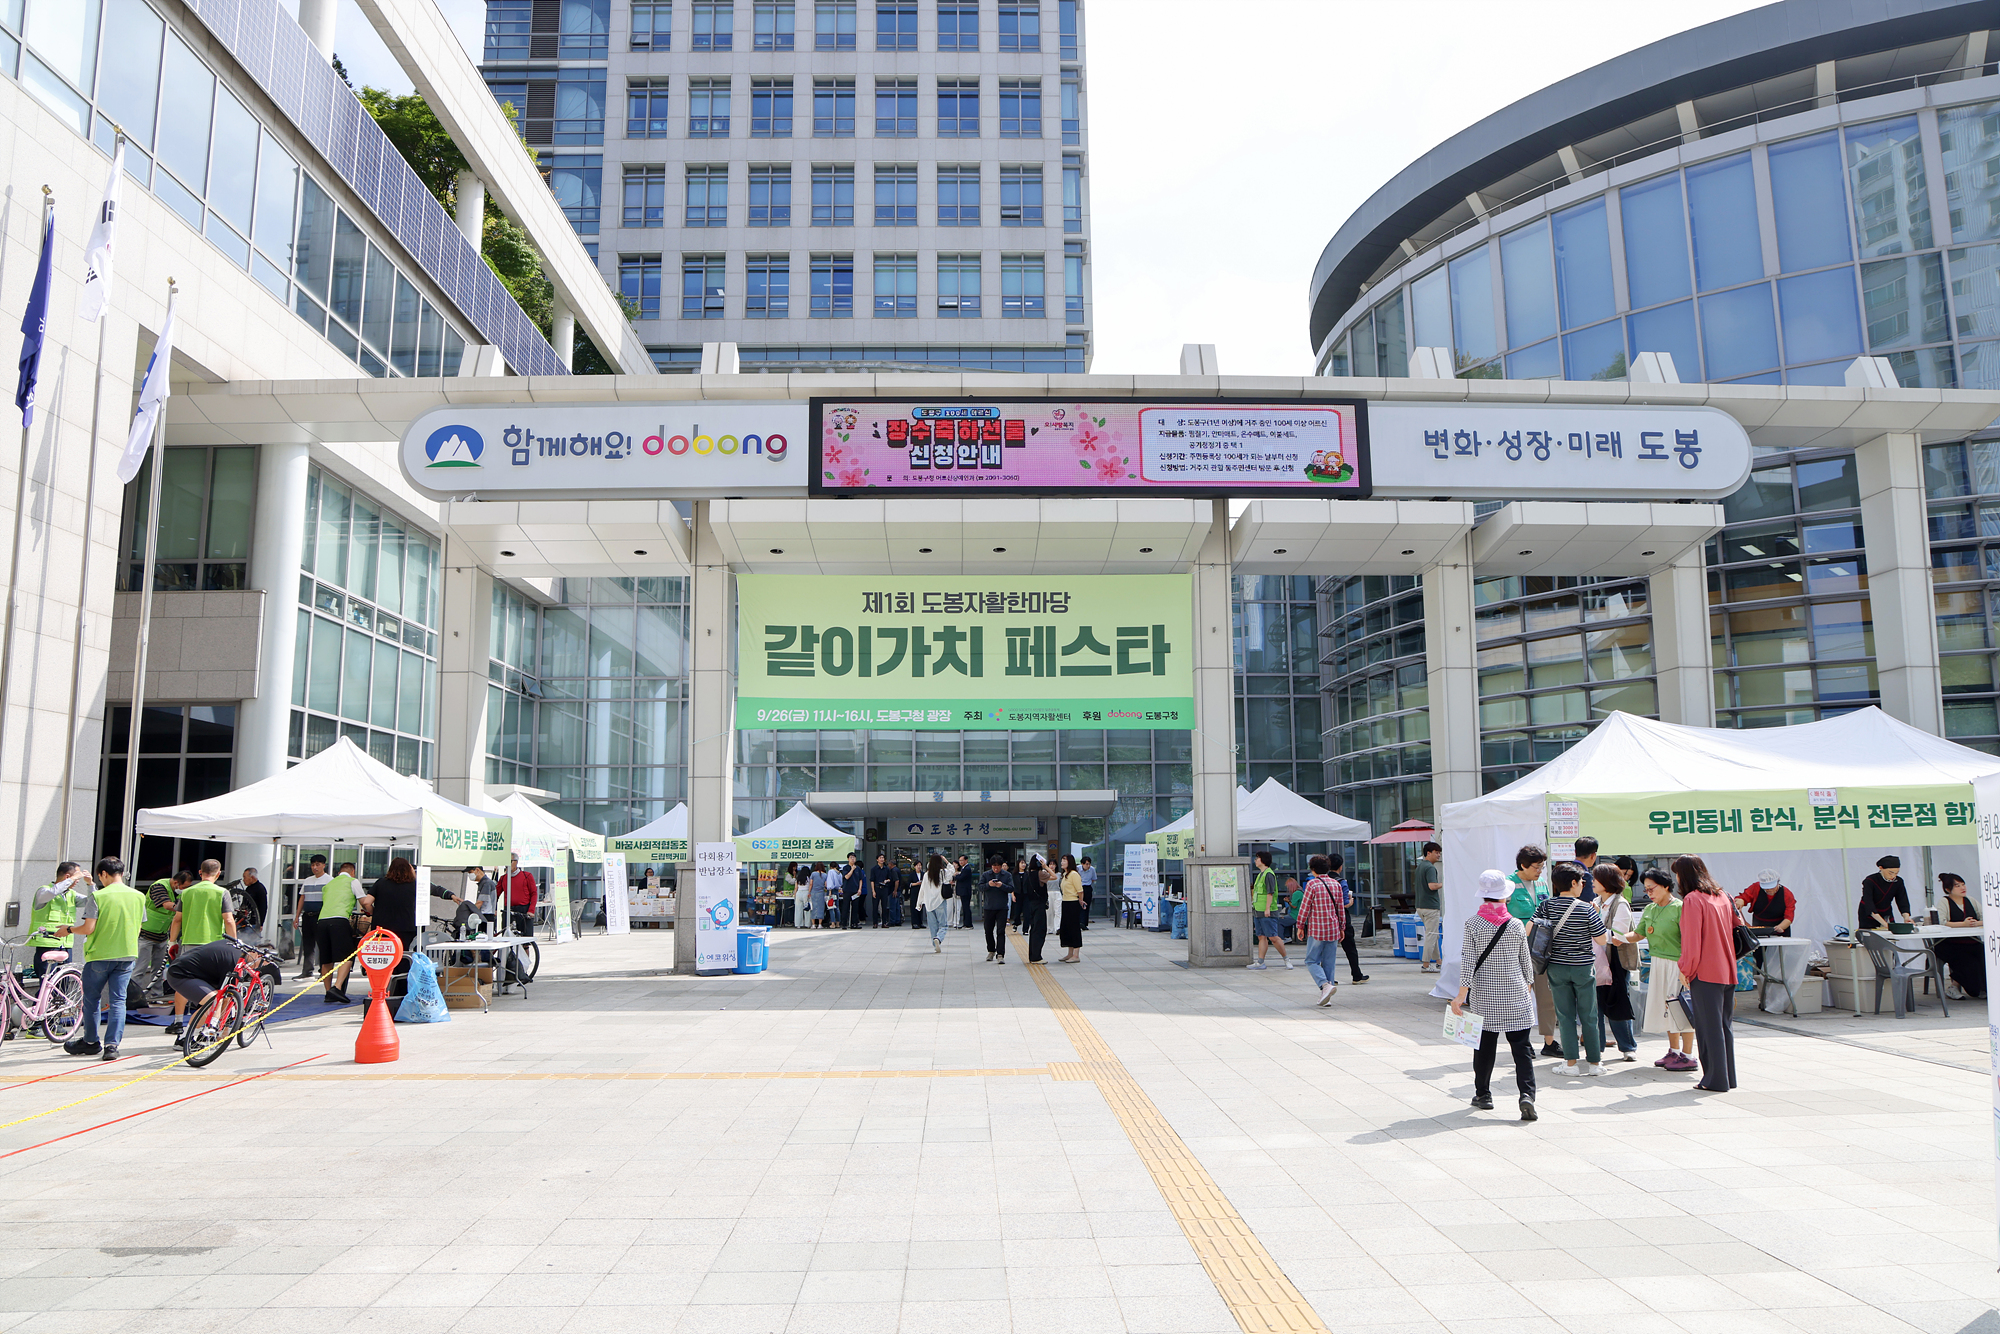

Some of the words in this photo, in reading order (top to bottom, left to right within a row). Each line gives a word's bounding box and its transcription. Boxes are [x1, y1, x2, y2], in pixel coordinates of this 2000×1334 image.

[921, 409, 942, 417] 도봉구
[945, 409, 967, 417] 100세
[1244, 419, 1258, 427] 거주
[1294, 420, 1307, 428] 이상
[1308, 420, 1328, 428] 어르신
[886, 419, 1026, 445] 장수축하선물
[502, 424, 632, 467] 함께해요!
[642, 424, 788, 463] dobong
[1423, 428, 1622, 462] 변화·성장·미래
[1637, 429, 1703, 470] 도봉
[909, 443, 1002, 467] 신청안내
[861, 591, 915, 614] 제1회
[921, 591, 1071, 614] 도봉자활한마당
[764, 624, 984, 678] 같이가치
[1004, 623, 1171, 677] 페스타
[756, 709, 810, 723] 9/26(금)
[813, 709, 874, 724] 11시~16시,
[876, 709, 925, 723] 도봉구청
[926, 709, 952, 723] 광장
[964, 711, 983, 721] 주최
[1008, 712, 1072, 722] 도봉지역자활센터
[1082, 711, 1102, 721] 후원
[1107, 709, 1143, 720] dobong
[1145, 711, 1179, 721] 도봉구청
[1648, 808, 1743, 836] 우리동네
[1749, 807, 1803, 832] 한식,
[1813, 804, 1860, 830] 분식
[1867, 801, 1938, 829] 전문점
[930, 823, 990, 836] 도봉구청
[436, 828, 462, 850] 자전거
[463, 829, 479, 850] 무료
[480, 830, 505, 852] 스팀청소
[615, 839, 687, 850] 바꿈사회적협동조
[752, 839, 780, 850] GS25
[781, 839, 813, 850] 편의점
[814, 838, 834, 850] 상품
[651, 852, 687, 861] 드립백커피
[698, 851, 733, 861] 다회용기
[780, 852, 815, 860] 모아모아~
[698, 866, 734, 877] 반납장소
[607, 870, 617, 927] 도봉여성센터
[365, 944, 392, 952] 주차금지
[706, 953, 736, 962] 에코워싱
